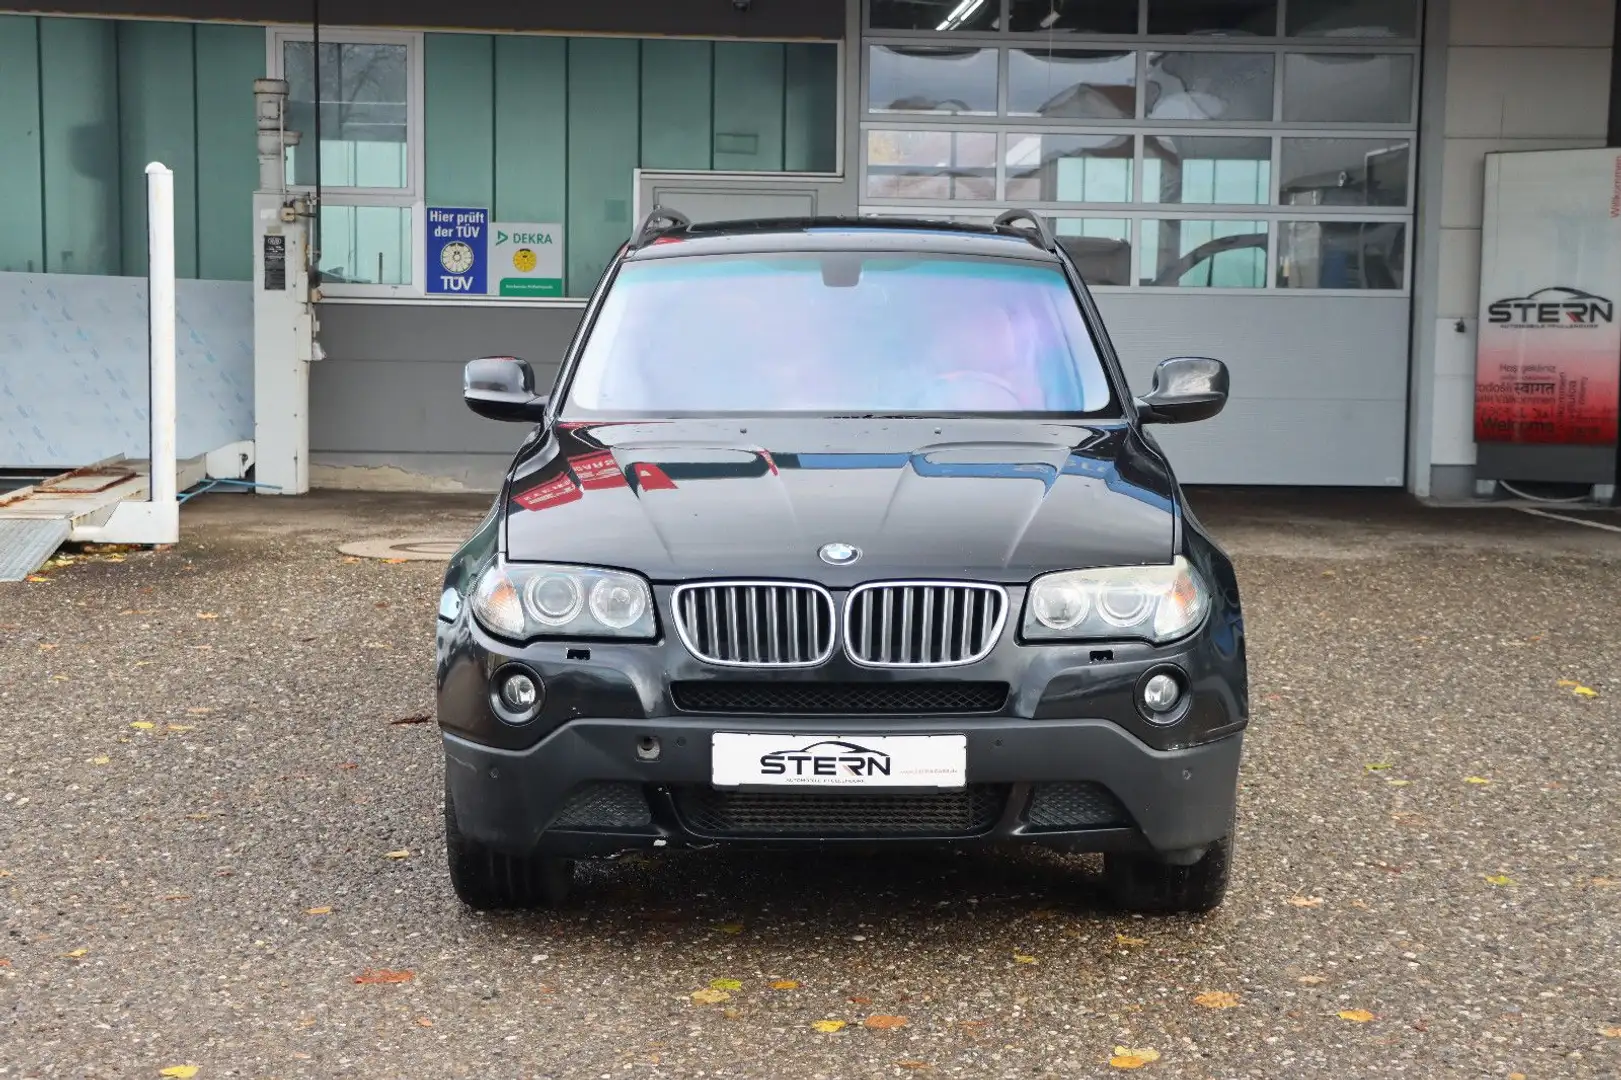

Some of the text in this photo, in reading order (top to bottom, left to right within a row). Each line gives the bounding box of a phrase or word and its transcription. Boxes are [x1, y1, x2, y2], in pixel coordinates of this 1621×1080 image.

[430, 211, 484, 225] Hier prüft
[434, 224, 480, 238] der TÜV
[513, 233, 553, 244] DEKRA
[440, 275, 473, 291] TÜV
[1488, 302, 1613, 323] STERN
[760, 755, 890, 776] STERN
